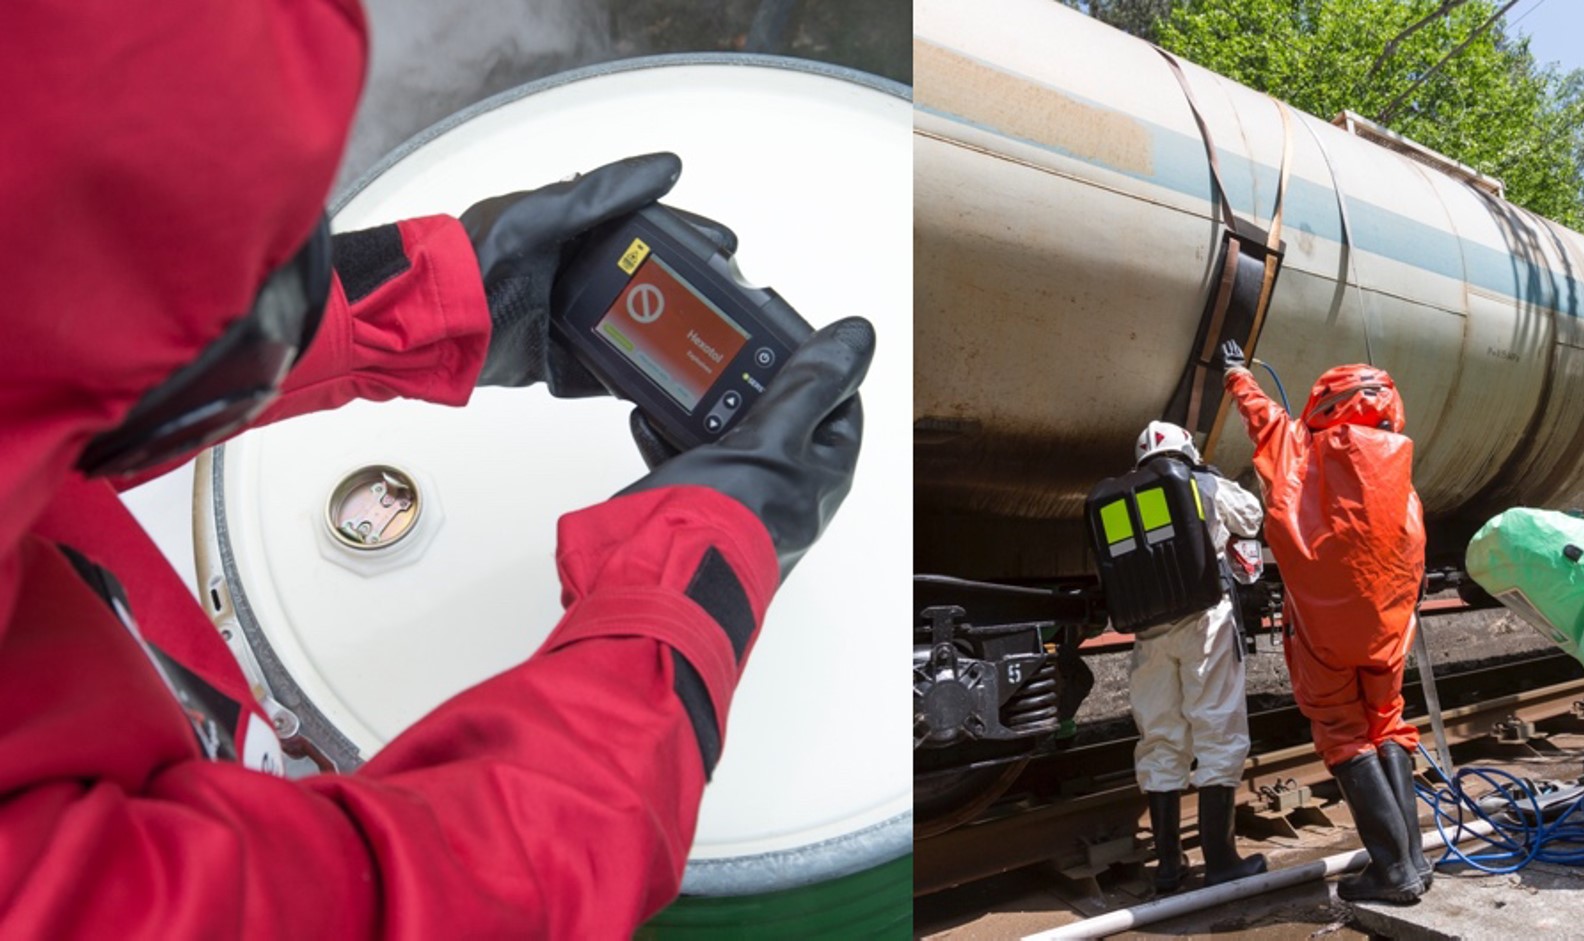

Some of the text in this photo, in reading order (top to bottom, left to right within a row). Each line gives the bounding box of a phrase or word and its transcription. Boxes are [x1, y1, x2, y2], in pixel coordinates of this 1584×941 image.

[687, 329, 724, 364] Hexotol
[748, 377, 765, 393] SERS
[1008, 663, 1021, 684] 5
